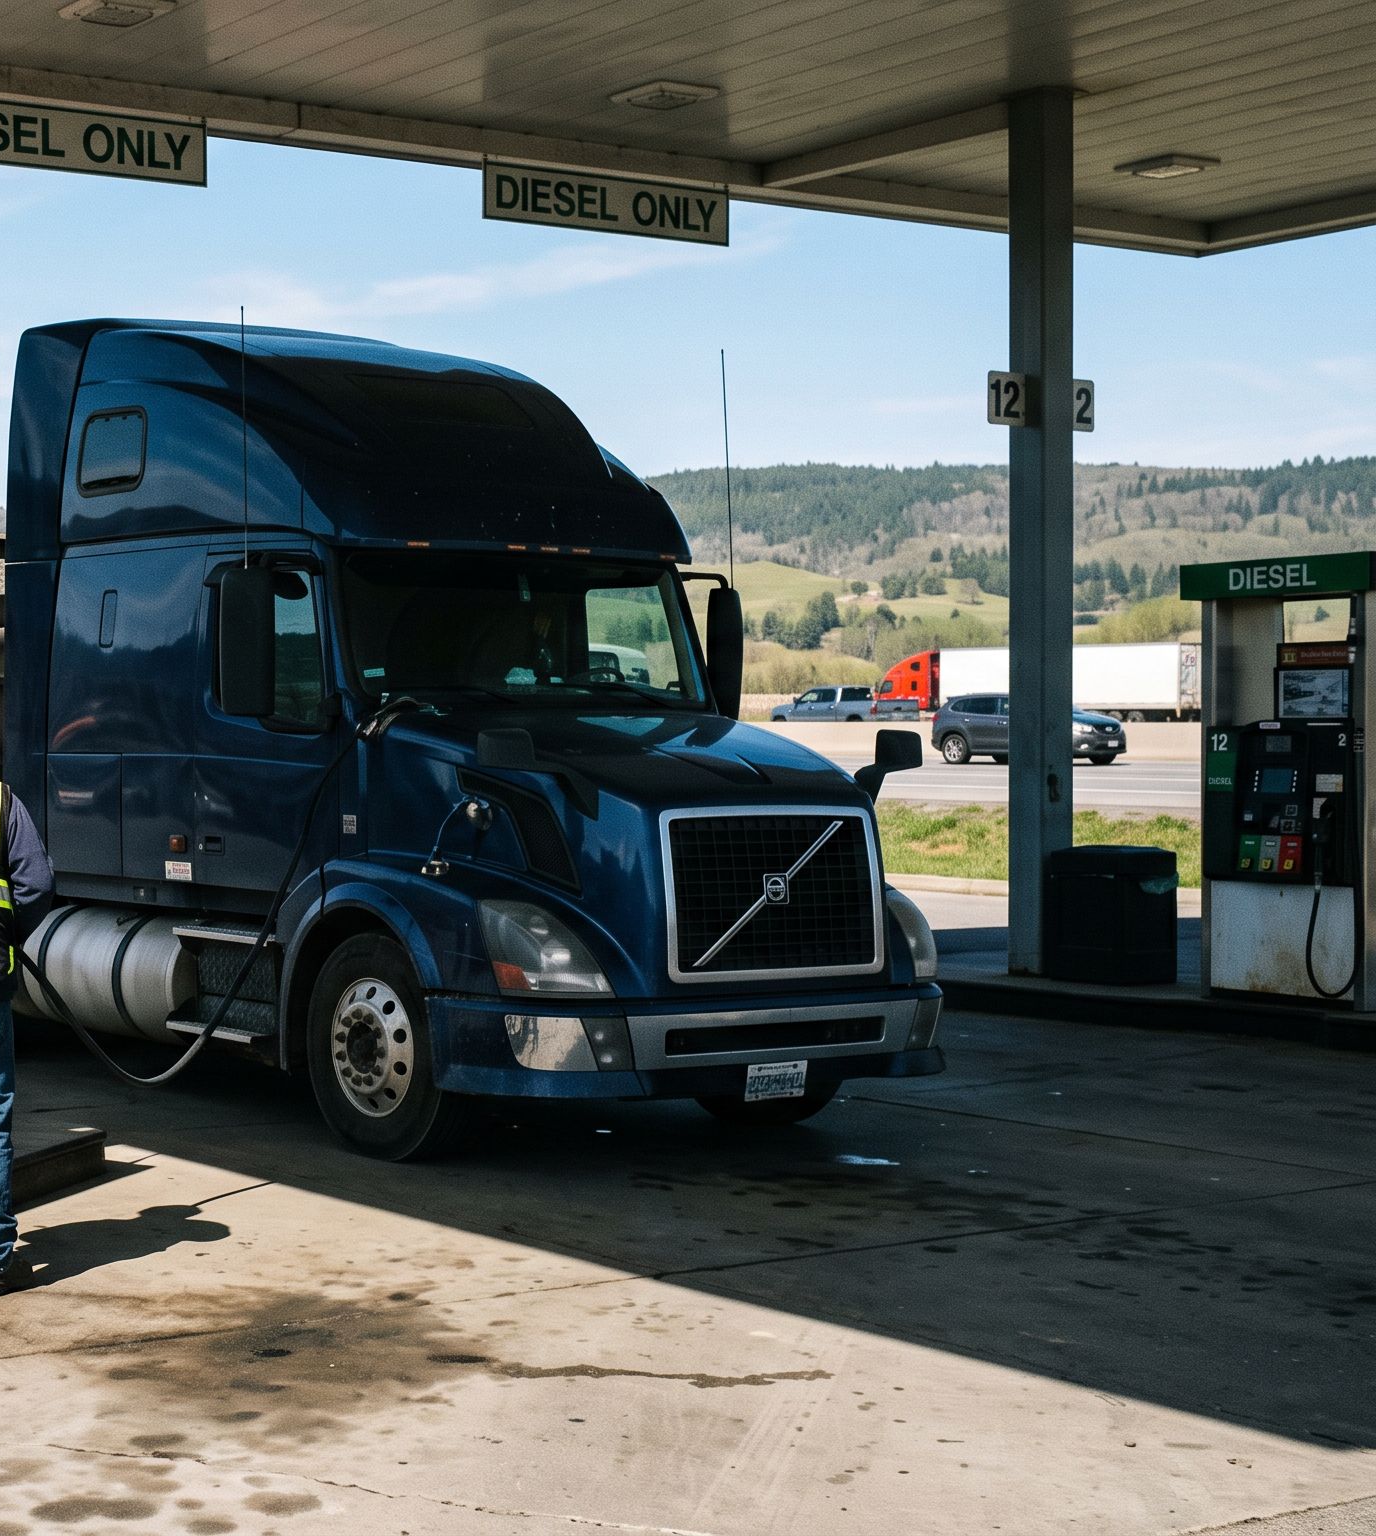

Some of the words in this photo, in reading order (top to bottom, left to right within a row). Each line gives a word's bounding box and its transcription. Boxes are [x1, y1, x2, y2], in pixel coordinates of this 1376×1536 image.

[82, 123, 191, 171] ONLY
[496, 174, 619, 222] DIESEL
[632, 191, 717, 233] ONLY
[990, 379, 1021, 418] 12
[1228, 563, 1317, 591] DIESEL
[1211, 733, 1228, 751] 12
[1338, 733, 1347, 747] 2
